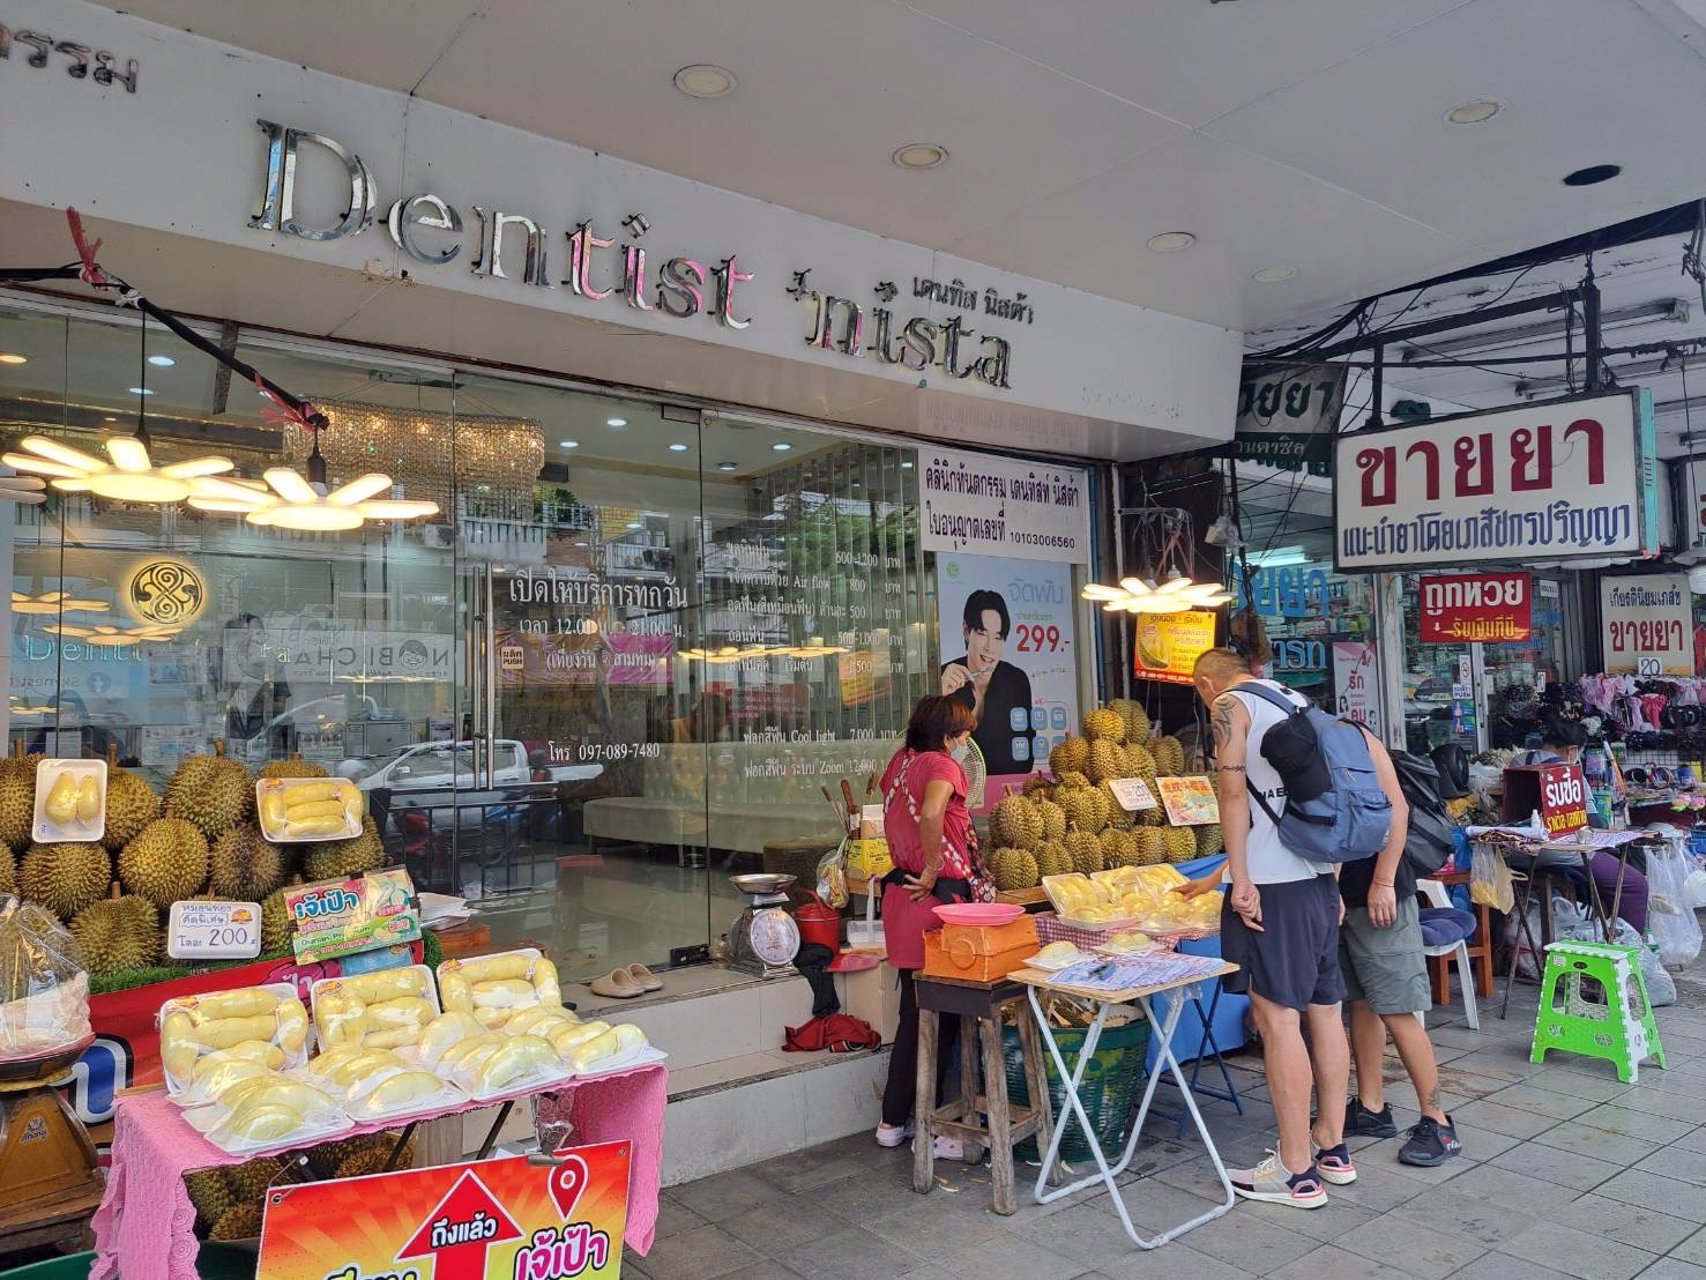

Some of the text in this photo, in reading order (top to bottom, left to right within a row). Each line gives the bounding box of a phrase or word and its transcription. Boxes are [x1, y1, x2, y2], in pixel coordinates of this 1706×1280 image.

[246, 117, 755, 333] Dentist
[925, 457, 1007, 499] คลินิกทันตกรรม
[1355, 418, 1606, 508] ขายยา
[926, 499, 1076, 550] ใบอนุญาตเลขที่ 10103006560
[1343, 499, 1632, 558] แนะนำยาโดยเภสัชกรปริญญา
[509, 566, 688, 618] เปิดให้บริการทุกวัน
[849, 578, 866, 593] 800
[1424, 578, 1523, 616] ถูกหวย
[849, 604, 866, 619] 500
[1609, 619, 1684, 652] ขายยา
[502, 657, 524, 665] PUSH
[1640, 657, 1661, 677] 20
[548, 741, 661, 763] โทร 097-089-7480
[294, 888, 360, 920] เจ้เป้า
[208, 926, 249, 947] 200
[430, 1211, 498, 1250] ถึงแล้ว
[515, 1221, 608, 1280] เจ้เป้า
